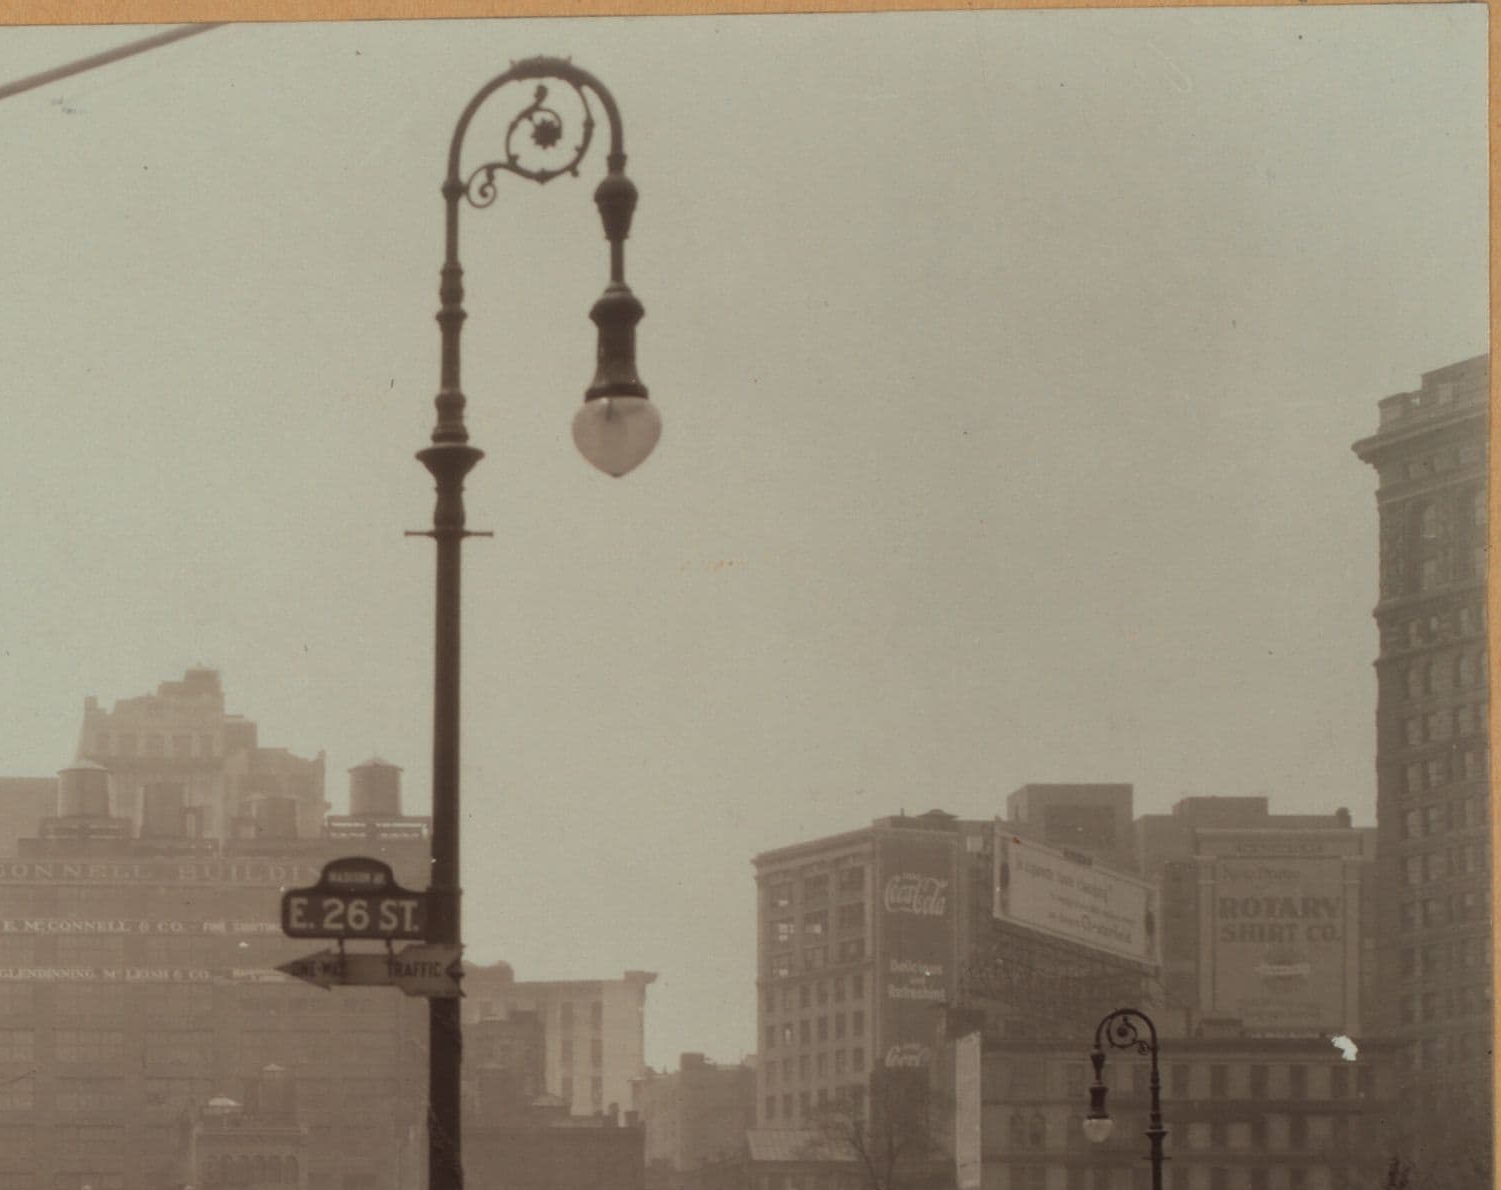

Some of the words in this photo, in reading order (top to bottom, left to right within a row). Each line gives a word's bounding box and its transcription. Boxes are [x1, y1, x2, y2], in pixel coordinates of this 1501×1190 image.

[179, 863, 321, 880] BUILDIN
[290, 897, 315, 930] E.
[321, 898, 370, 931] 26
[379, 898, 420, 932] ST.
[1219, 896, 1341, 920] ROTARY
[1219, 922, 1297, 943] SHIRT
[1306, 923, 1342, 943] CO.
[388, 961, 442, 977] TRAFFIC
